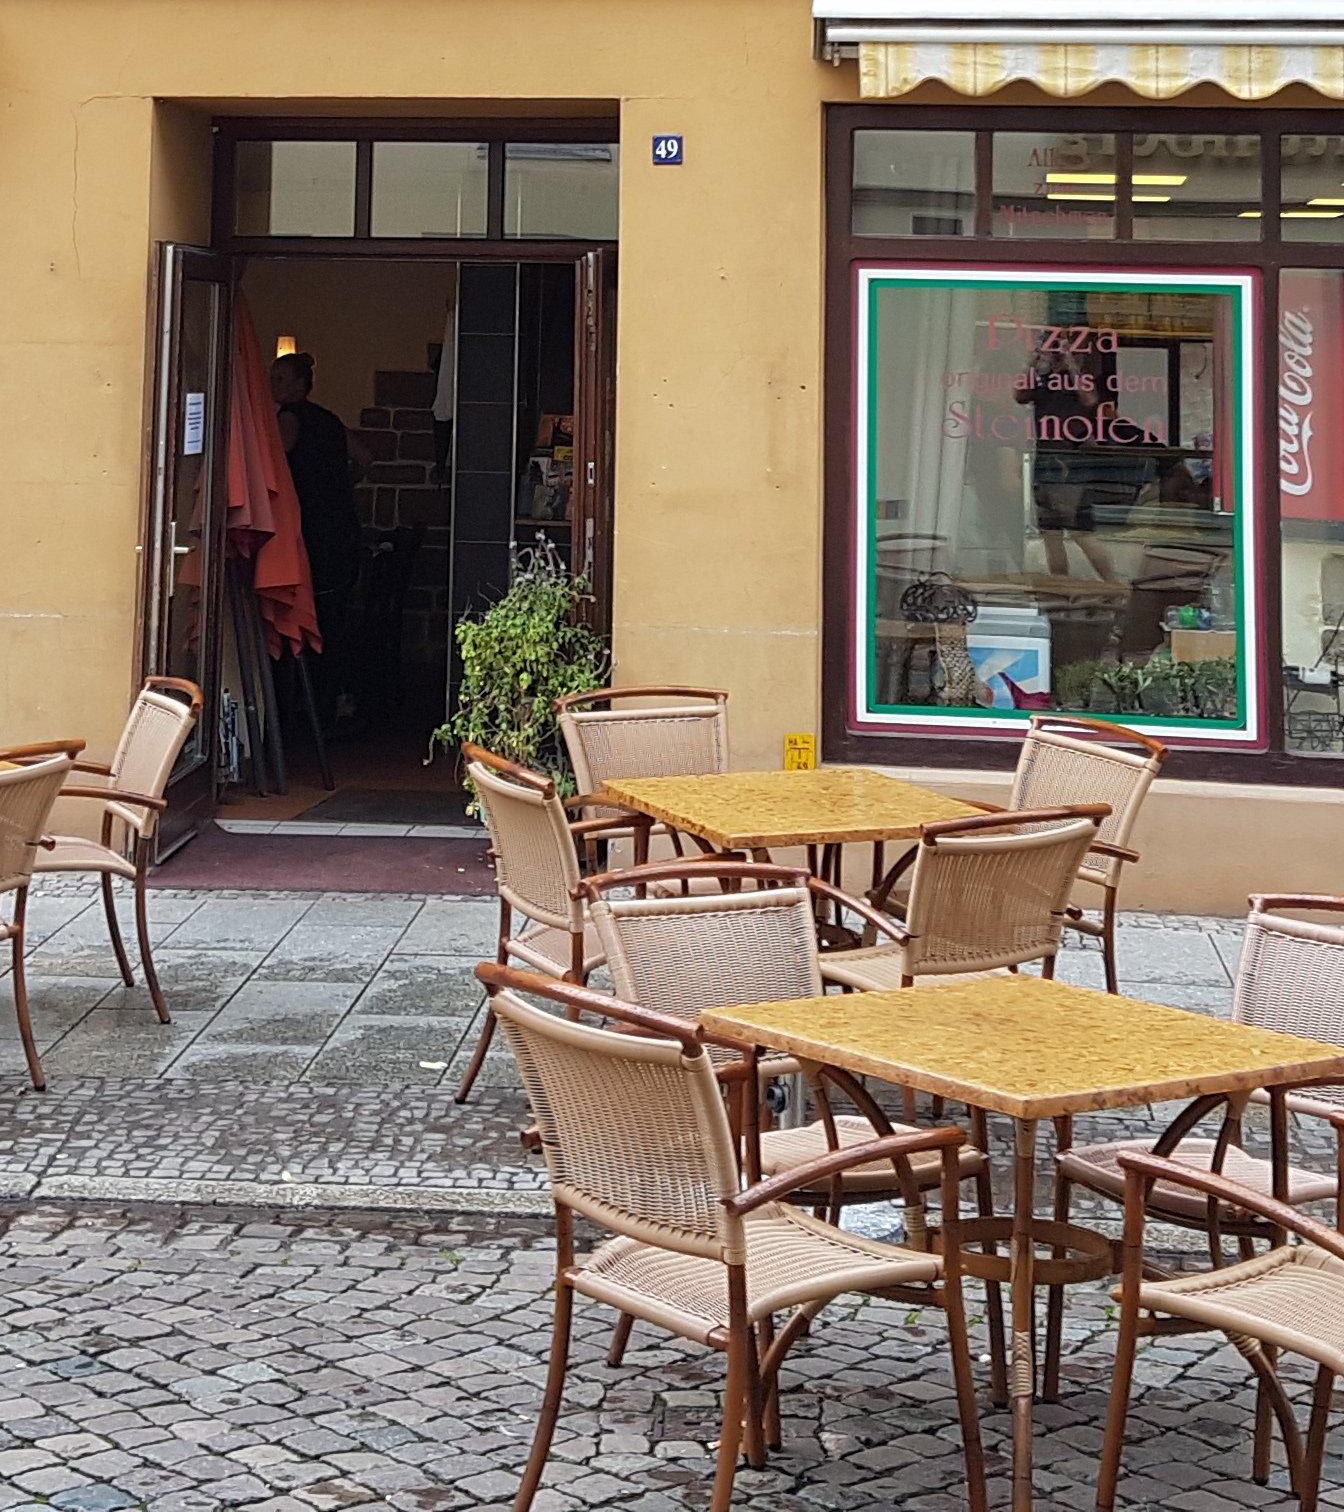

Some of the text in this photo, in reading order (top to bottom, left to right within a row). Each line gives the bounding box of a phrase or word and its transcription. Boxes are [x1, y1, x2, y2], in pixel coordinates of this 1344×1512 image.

[655, 139, 679, 159] 49
[986, 314, 1118, 354] Pizza
[941, 366, 1168, 400] original aus dem
[941, 399, 1169, 445] Steinofen
